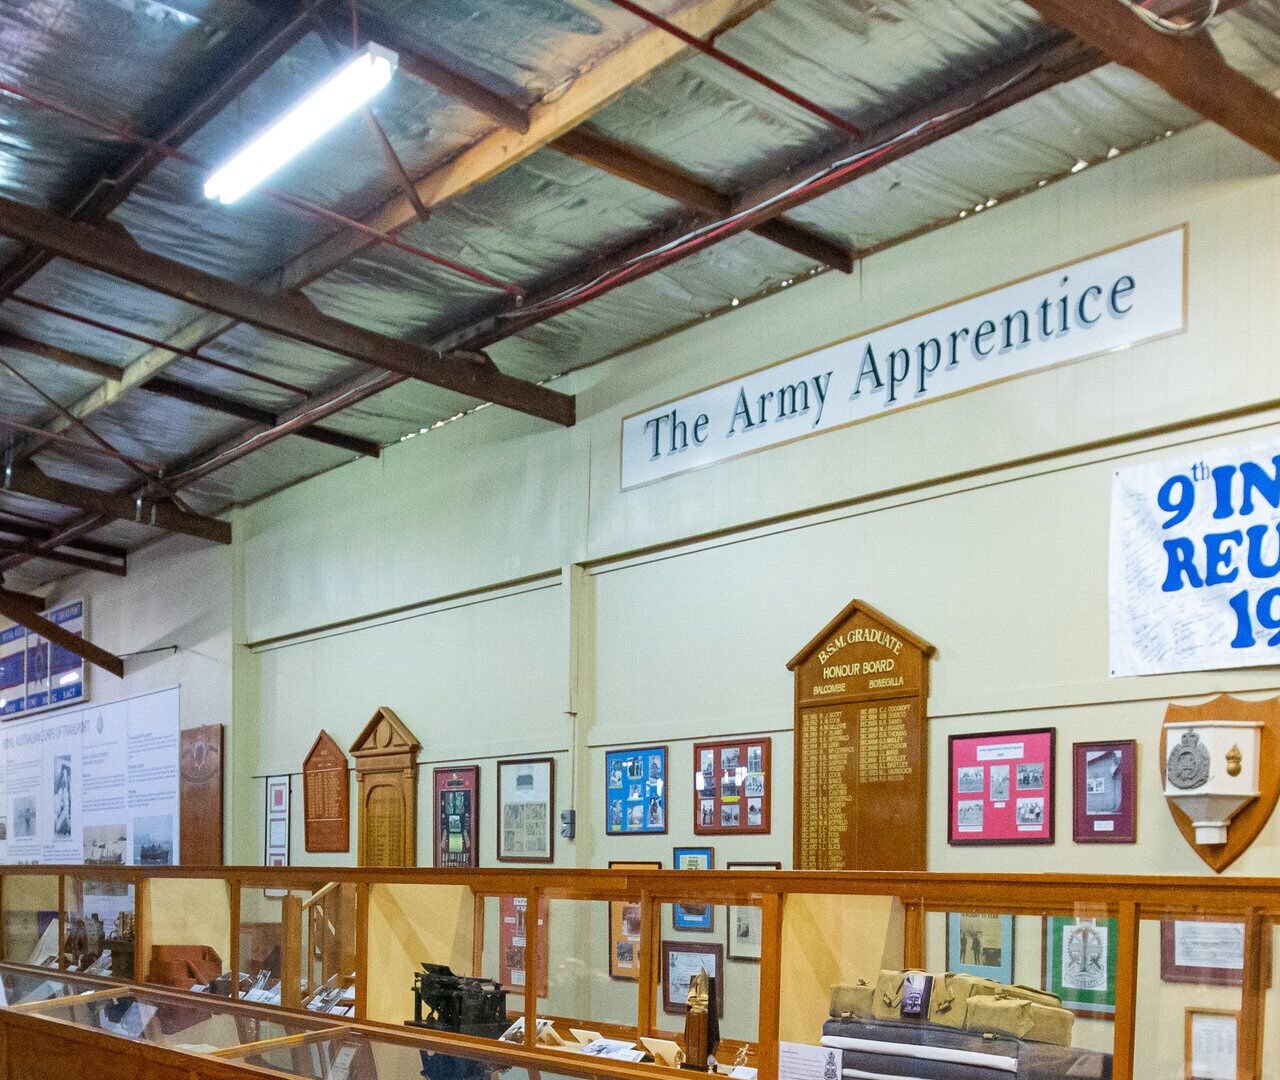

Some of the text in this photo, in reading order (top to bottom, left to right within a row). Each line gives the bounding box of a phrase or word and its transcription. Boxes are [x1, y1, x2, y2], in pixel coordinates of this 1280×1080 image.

[645, 273, 1136, 459] The Army Apprentice
[847, 628, 904, 656] GRADUATE
[823, 658, 895, 679] HONOUR BOARD
[813, 676, 904, 695] BALCOMBE BONEGILLA
